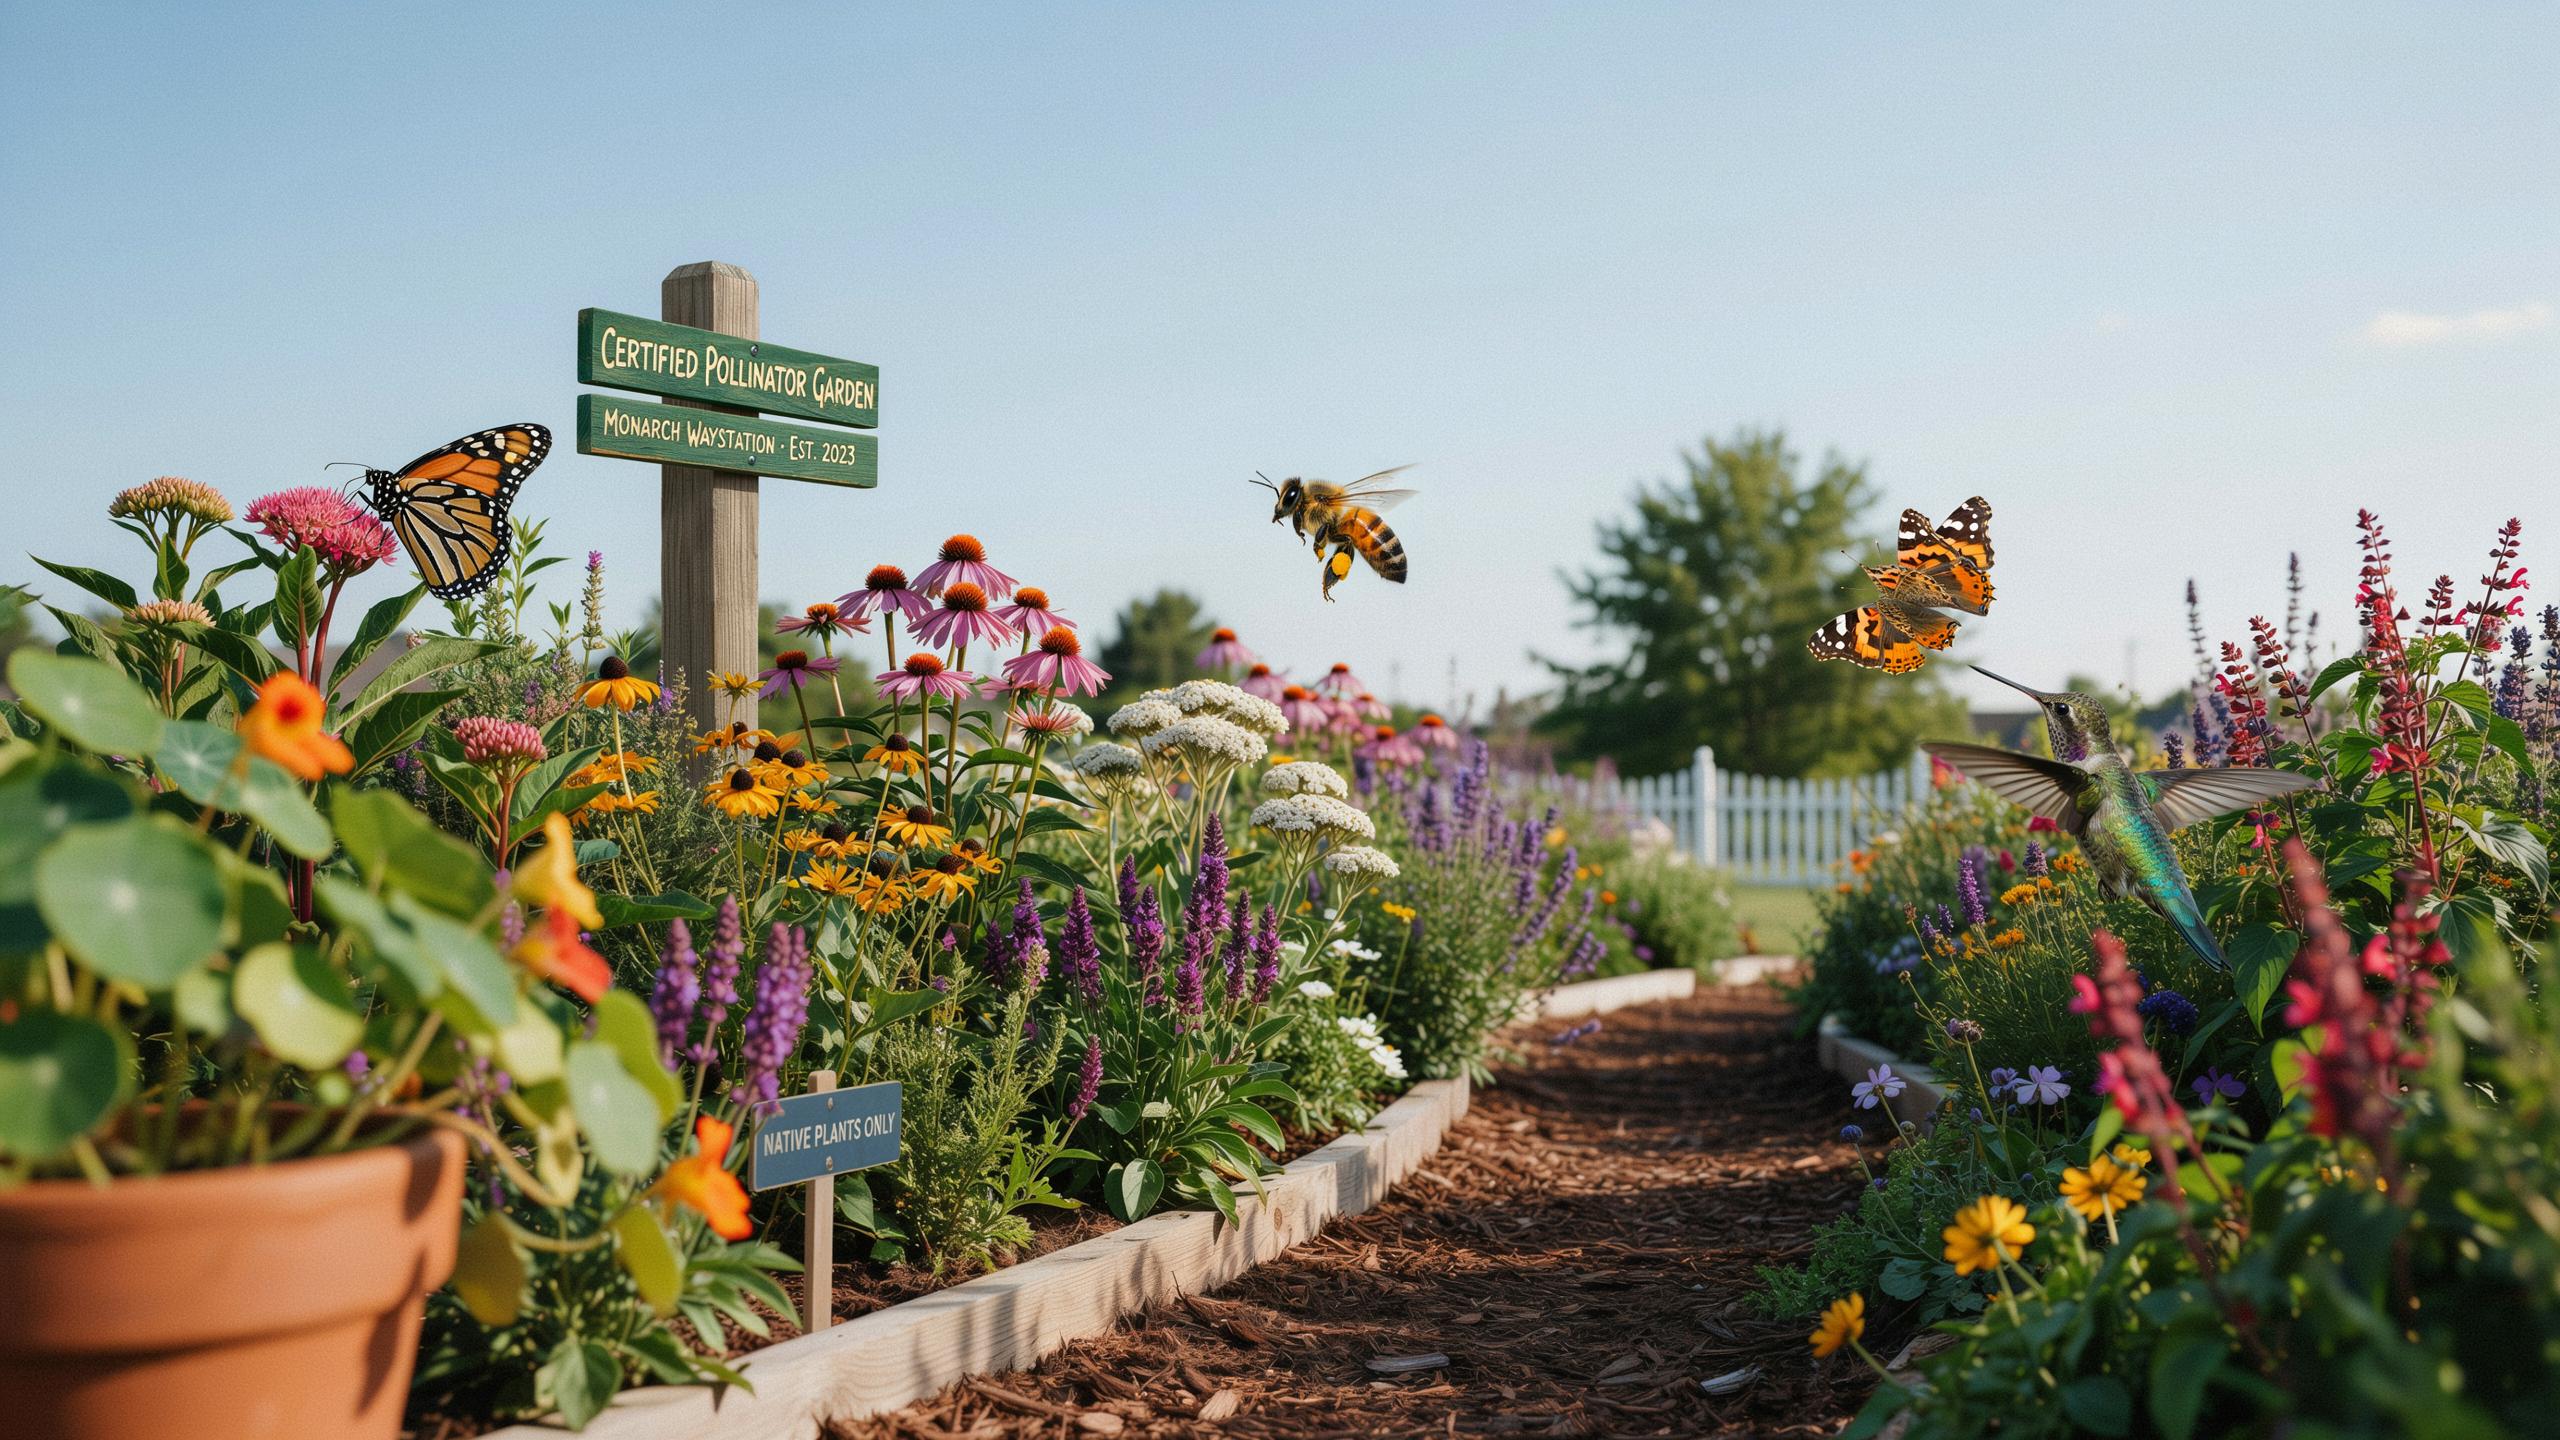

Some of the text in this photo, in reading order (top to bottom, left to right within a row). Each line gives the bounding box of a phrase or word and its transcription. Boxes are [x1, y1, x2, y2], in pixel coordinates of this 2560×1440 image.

[601, 326, 874, 409] CERTIFIED POLLINATOR GARDEN
[603, 408, 680, 442] MONARCH
[687, 420, 775, 454] WAYSTATION
[790, 435, 817, 461] EST.
[822, 444, 855, 466] 2023
[763, 1112, 896, 1157] NATIVE PLANTS ONLY
